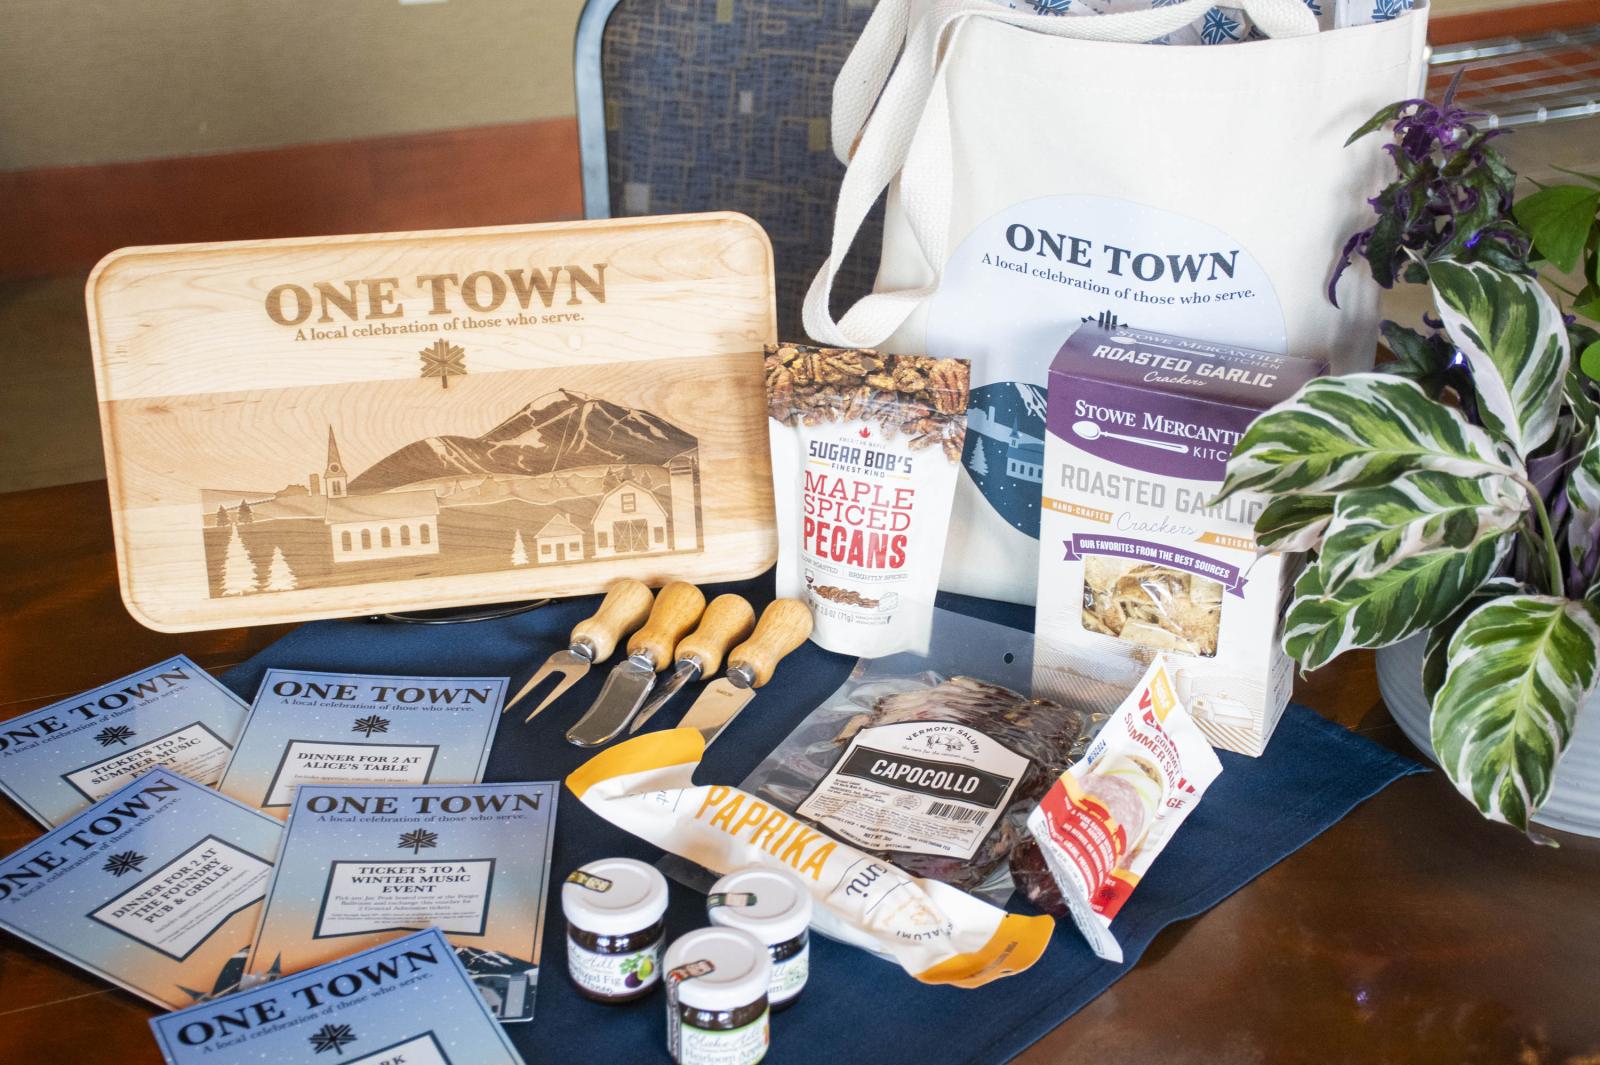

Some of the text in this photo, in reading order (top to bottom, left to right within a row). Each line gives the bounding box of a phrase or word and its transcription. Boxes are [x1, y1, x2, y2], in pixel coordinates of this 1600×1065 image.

[1006, 223, 1240, 283] ONE TOWN
[265, 262, 608, 326] ONE TOWN
[982, 252, 1256, 305] A local celebration of those who serve.
[294, 311, 584, 342] A local celebration of those who serve.
[1092, 344, 1278, 388] ROASTED GARLIC
[1116, 330, 1285, 364] STOWE MERCANTILE
[1218, 354, 1280, 370] KITCHEN
[1143, 372, 1208, 386] Crackers
[1075, 400, 1246, 446] STOWE MERCANTI
[809, 440, 861, 464] SUGAR
[864, 450, 912, 474] BOB'S
[832, 462, 885, 478] FINEST KIND
[1193, 446, 1232, 462] KITC
[804, 470, 914, 510] MAPLE
[1061, 463, 1166, 509] ROASTED
[804, 494, 910, 532] SPICED
[1052, 500, 1111, 522] HAND-CRAFTED
[1116, 512, 1195, 536] Crackers
[804, 516, 908, 569] PECANS
[1080, 539, 1231, 579] OUR FAVORITES FROM THE BEST SOURCES
[68, 667, 190, 720] TOWN
[273, 681, 492, 704] ONE TOWN
[320, 702, 376, 710] celebration
[14, 742, 40, 753] local
[41, 721, 97, 744] celebration
[110, 706, 136, 718] those
[138, 696, 159, 707] who
[906, 726, 954, 741] VERMONT
[957, 729, 979, 754] SALUMI
[1124, 712, 1166, 763] SUMMER
[91, 749, 153, 776] TICKETS
[153, 740, 174, 752] TO
[91, 757, 158, 784] SUMMER
[156, 738, 201, 760] MUSIC
[297, 752, 355, 762] DINNER
[303, 762, 409, 772] ALICE'S TABLE
[870, 759, 980, 794] CAPOCOLLO
[61, 778, 179, 850] TOWN
[306, 793, 544, 814] ONE TOWN
[100, 842, 110, 850] of
[695, 785, 839, 881] PAPRIKA
[112, 884, 166, 918] DINNER
[164, 866, 192, 884] FOR
[203, 848, 217, 862] AT
[130, 896, 162, 918] THE
[160, 858, 222, 900] FOUNDRY
[144, 906, 174, 924] PUB
[175, 898, 186, 906] &
[184, 865, 232, 897] GRILLE
[178, 944, 440, 1046] ONE TOWN
[215, 1032, 247, 1050] local
[250, 1010, 319, 1039] celebration
[321, 1006, 335, 1016] of
[337, 995, 369, 1010] those
[370, 984, 396, 998] who
